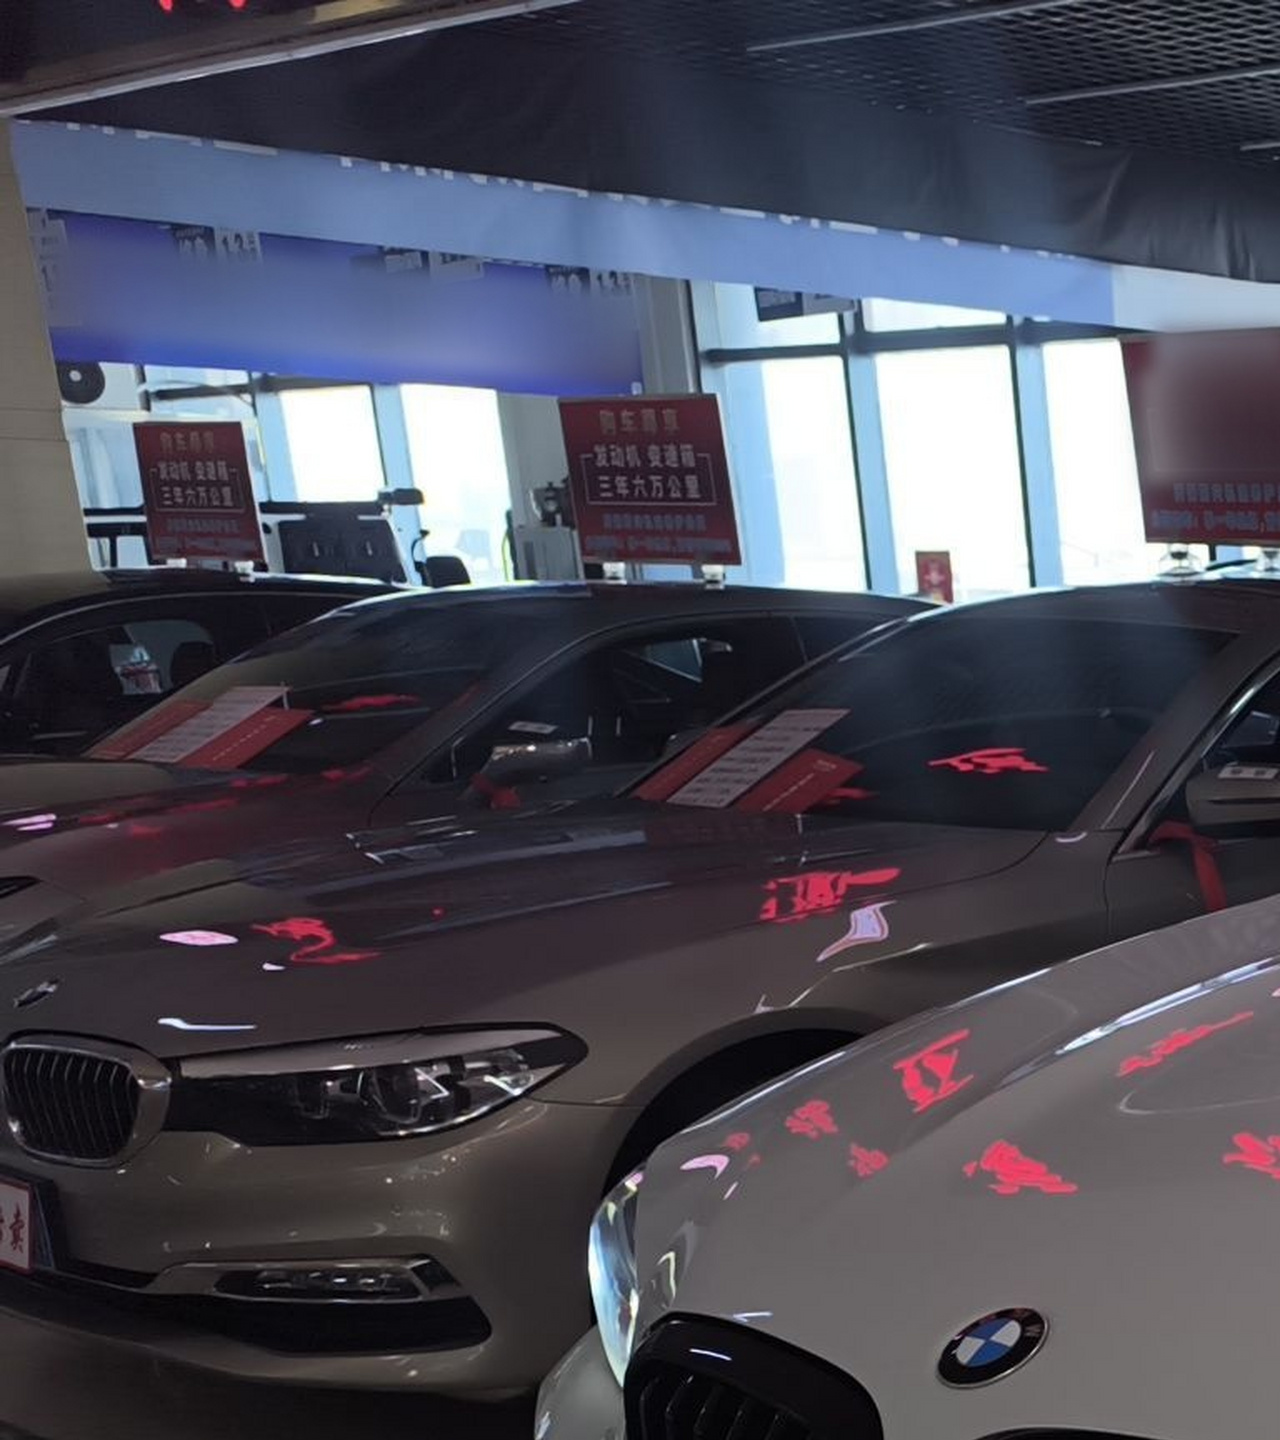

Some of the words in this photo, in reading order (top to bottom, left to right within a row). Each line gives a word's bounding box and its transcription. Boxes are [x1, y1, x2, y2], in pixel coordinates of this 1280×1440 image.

[594, 443, 641, 467] 发动机
[648, 443, 697, 467] 变速箱
[598, 475, 702, 499] 三年六万公里
